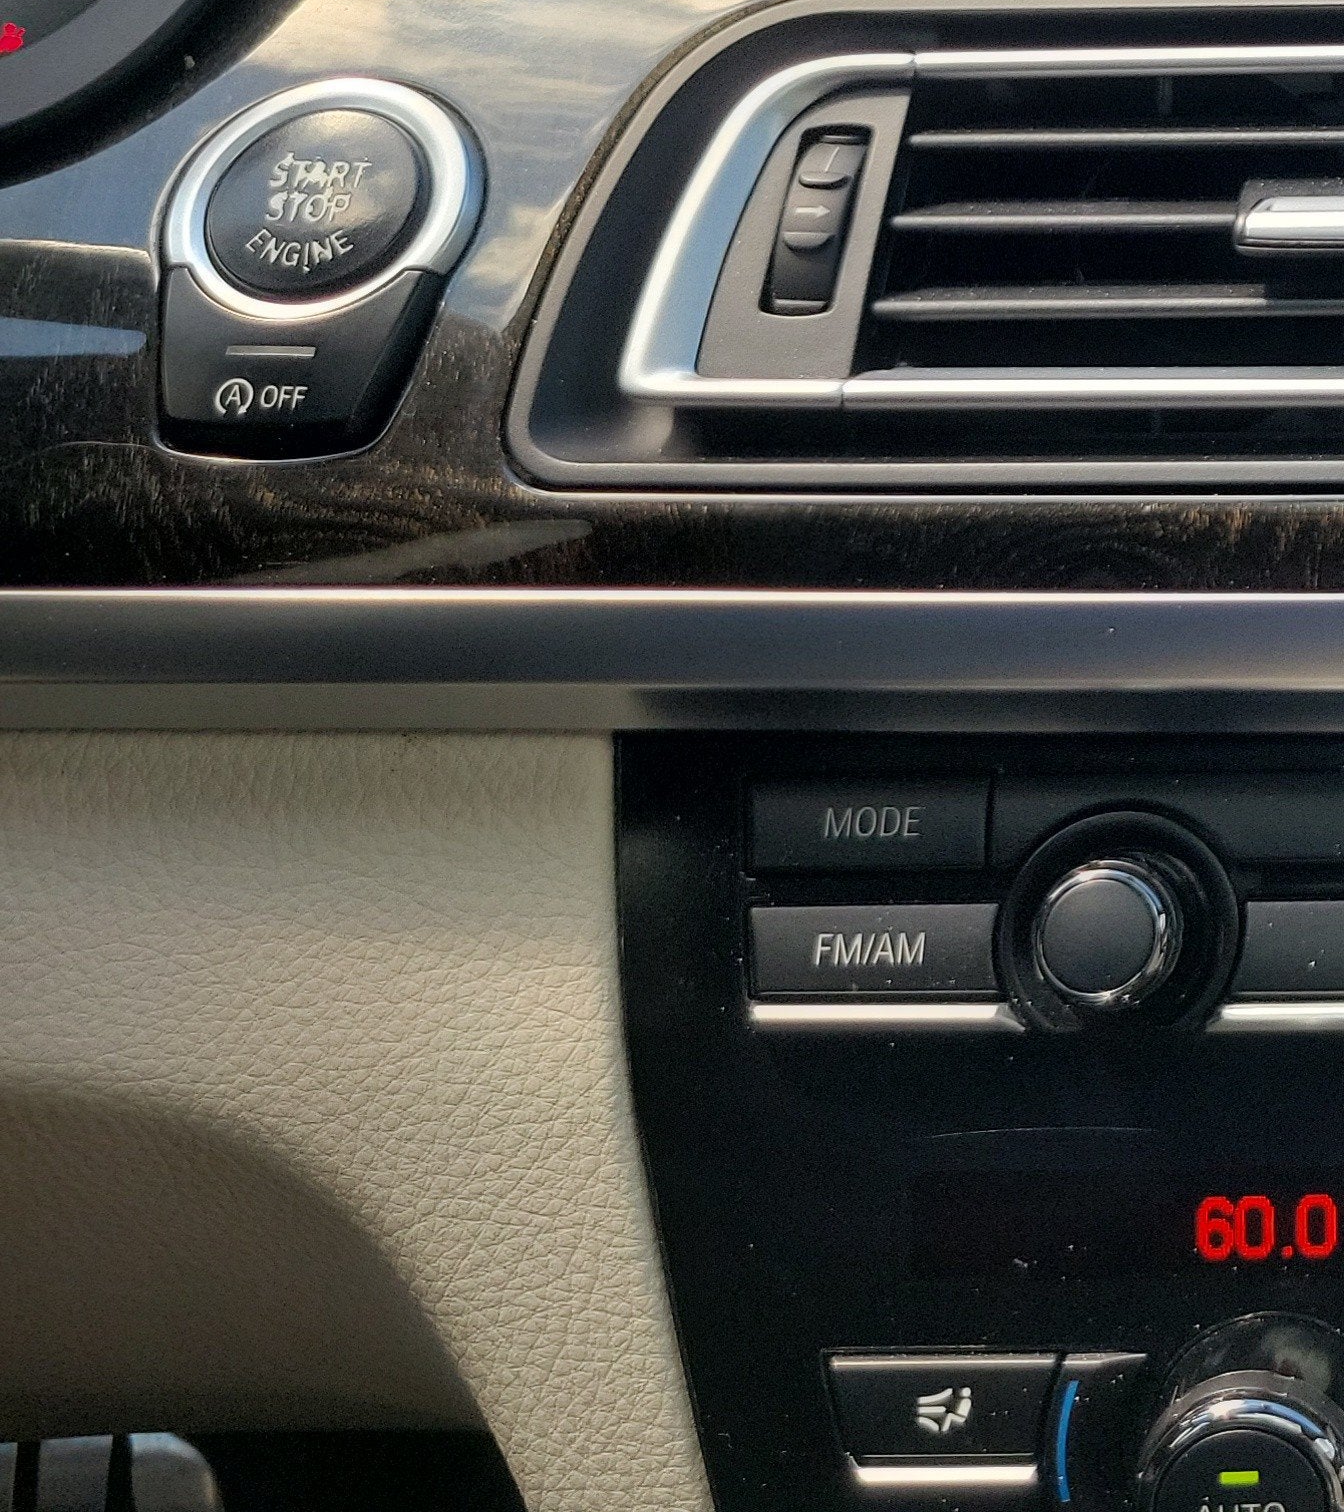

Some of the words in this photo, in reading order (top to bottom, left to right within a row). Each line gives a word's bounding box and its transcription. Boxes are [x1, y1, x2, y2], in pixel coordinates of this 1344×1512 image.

[269, 152, 373, 189] START
[265, 190, 351, 223] STOP
[245, 228, 355, 268] ENGINE
[260, 384, 308, 411] OFF
[823, 805, 927, 839] MODE
[812, 932, 927, 967] FM/AM
[1196, 1193, 1338, 1261] 60.0
